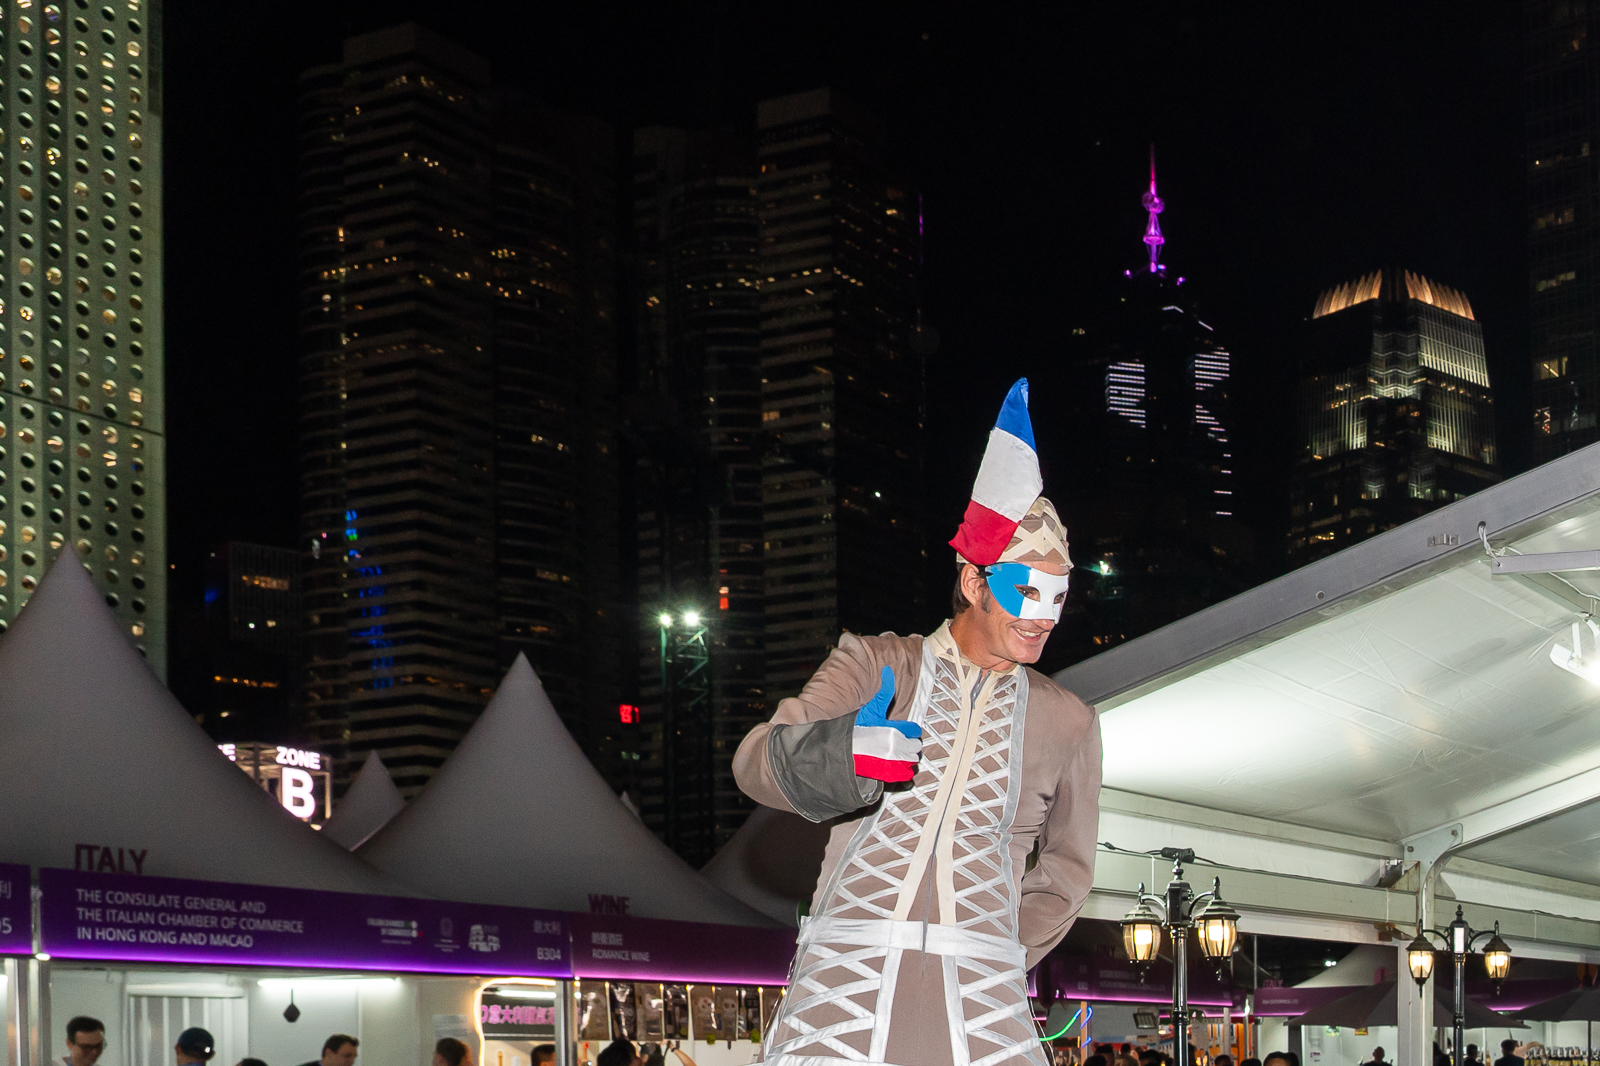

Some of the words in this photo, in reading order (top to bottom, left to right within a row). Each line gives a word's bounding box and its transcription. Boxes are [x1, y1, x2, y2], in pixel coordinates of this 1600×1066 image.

[275, 746, 321, 770] ZONE
[281, 768, 316, 819] B
[75, 843, 148, 876] ITALY
[76, 888, 102, 904] THE
[105, 890, 181, 909] CONSULATE
[183, 896, 238, 912] GENERAL
[240, 900, 267, 914] AND
[588, 893, 630, 916] WINE
[76, 907, 102, 922] THE
[105, 908, 156, 924] ITALIAN
[158, 912, 219, 929] CHAMBER
[220, 916, 238, 929] OF
[238, 917, 304, 934] COMMERCE
[77, 926, 92, 941] IN
[95, 927, 137, 942] HONG
[139, 929, 178, 945] KONG
[179, 932, 207, 946] AND
[209, 933, 254, 948] MACAO
[537, 947, 562, 961] B304
[592, 948, 631, 962] ROMANCE
[631, 951, 651, 962] WINE
[1262, 979, 1284, 990] ITALY
